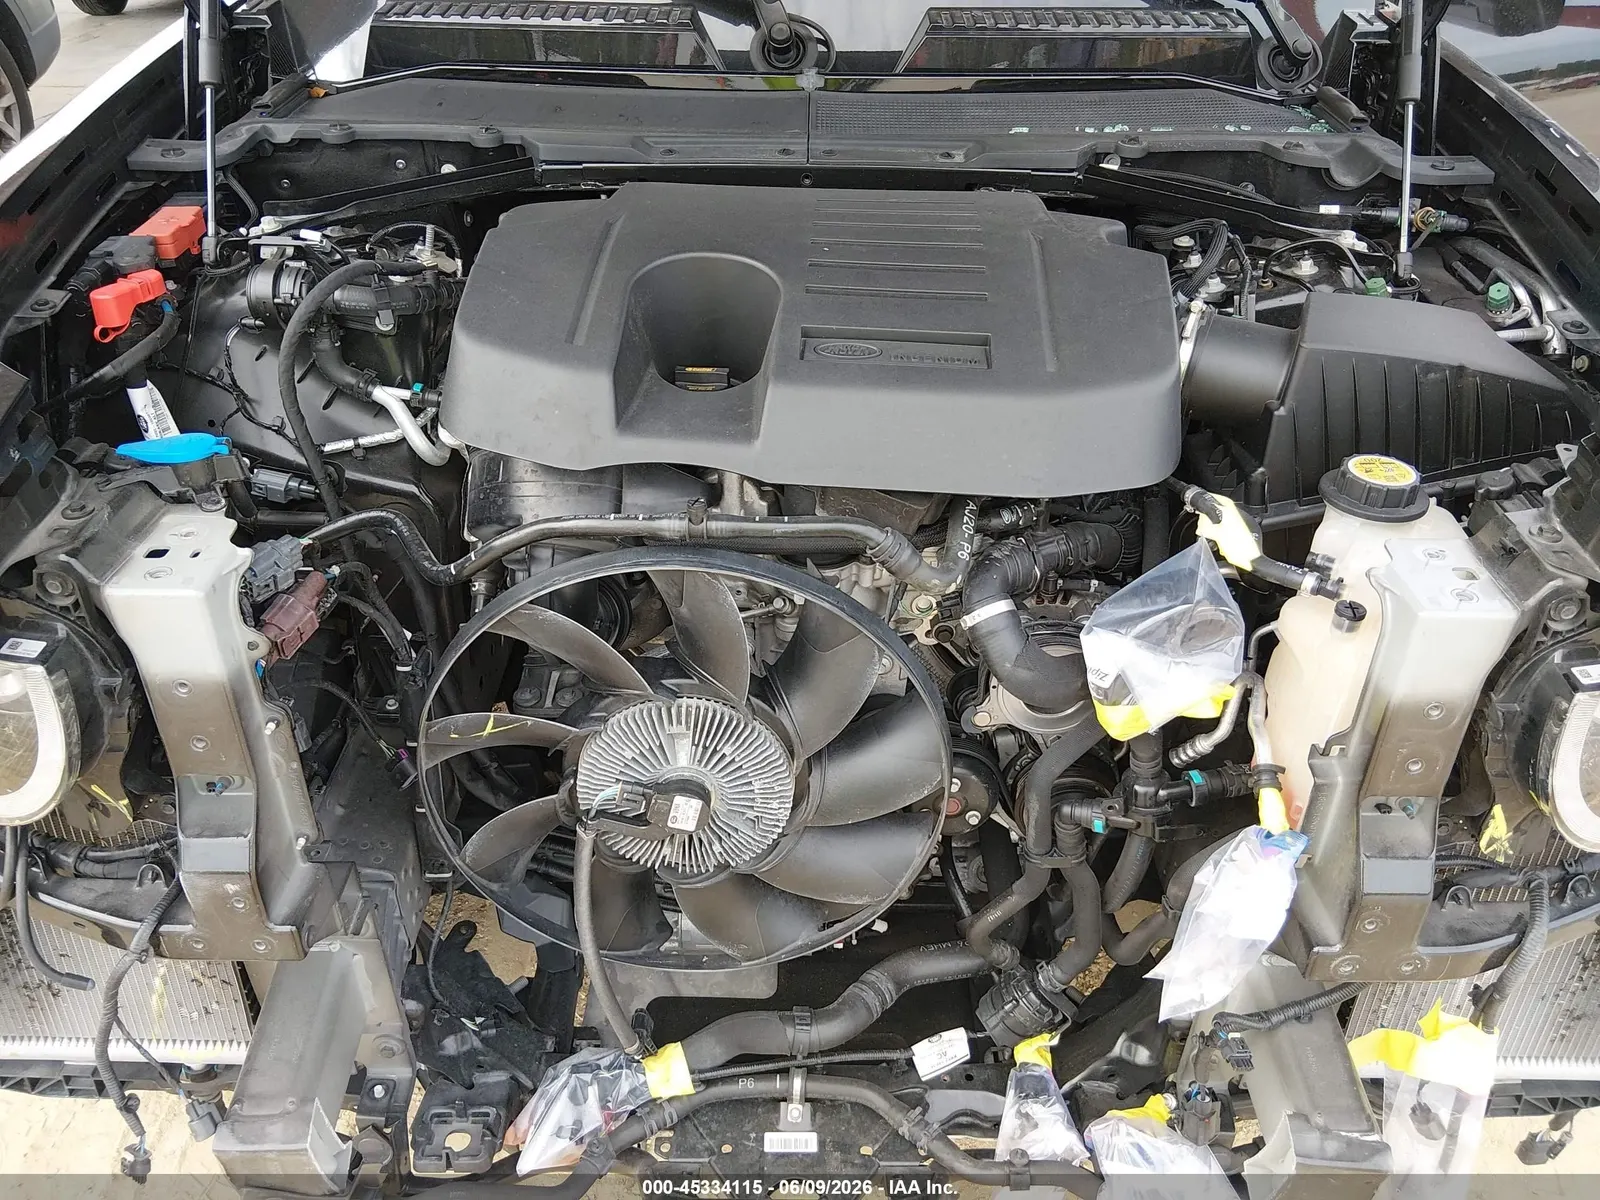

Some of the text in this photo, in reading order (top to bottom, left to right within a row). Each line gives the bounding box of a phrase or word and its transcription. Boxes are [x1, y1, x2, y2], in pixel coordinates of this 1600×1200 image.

[957, 499, 977, 561] AJ20- P6
[1275, 561, 1303, 575] TANK
[738, 1077, 755, 1089] P6
